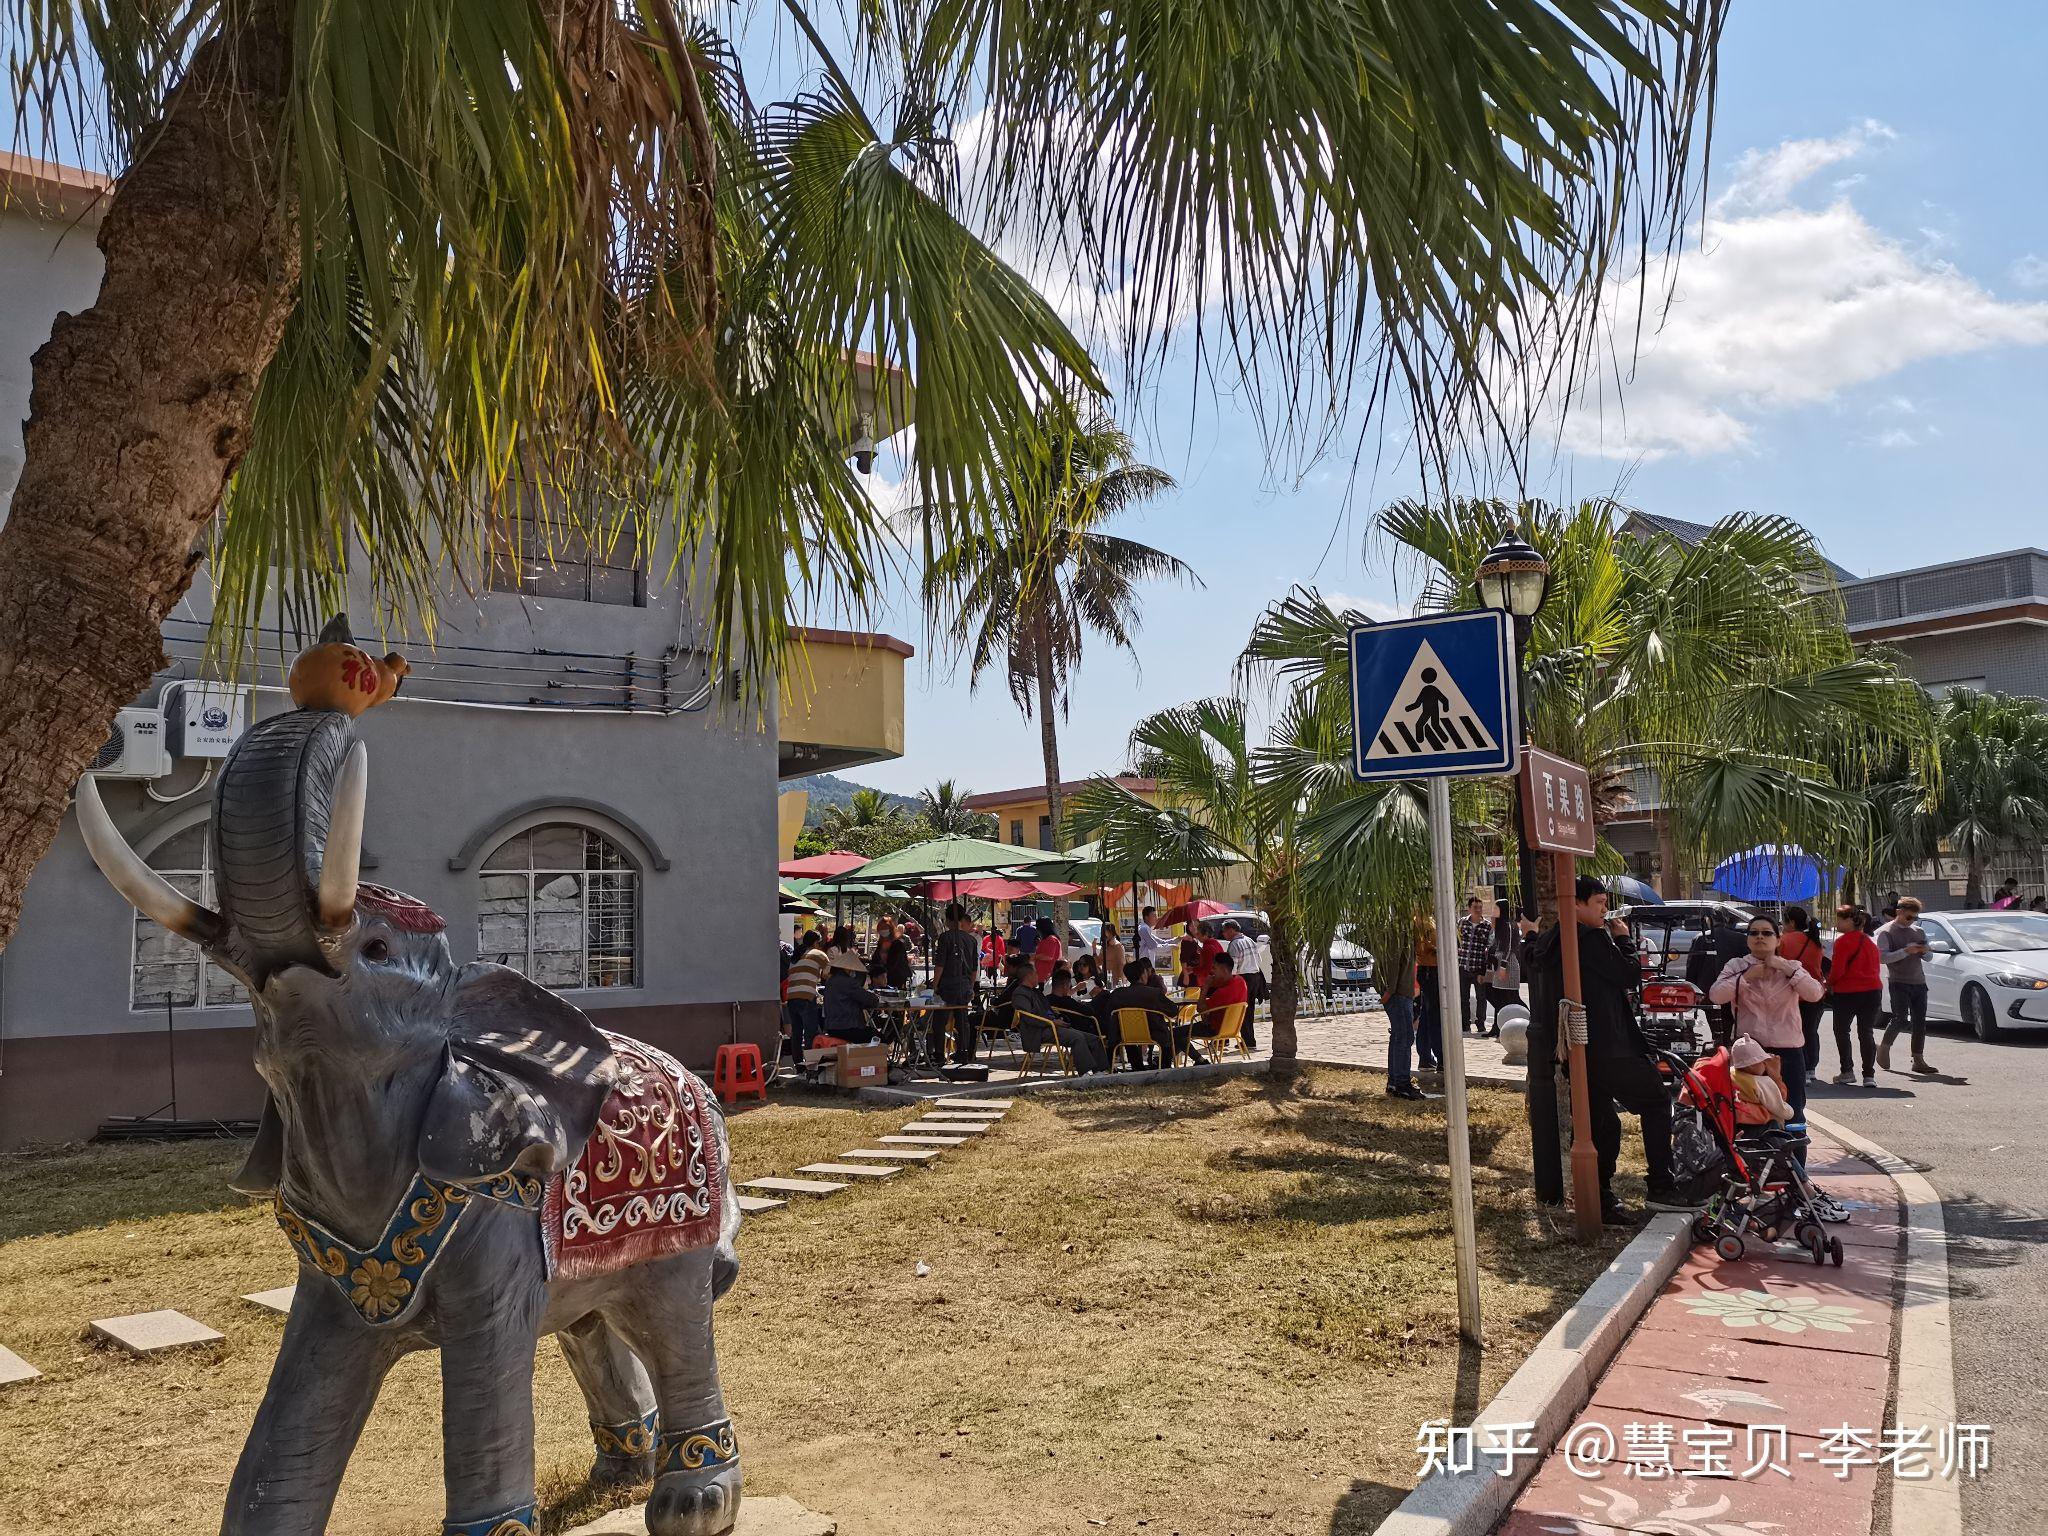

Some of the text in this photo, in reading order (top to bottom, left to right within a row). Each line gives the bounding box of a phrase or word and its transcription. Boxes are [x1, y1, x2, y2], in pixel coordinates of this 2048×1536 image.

[134, 722, 158, 730] AUX
[1542, 771, 1585, 823] 百果路
